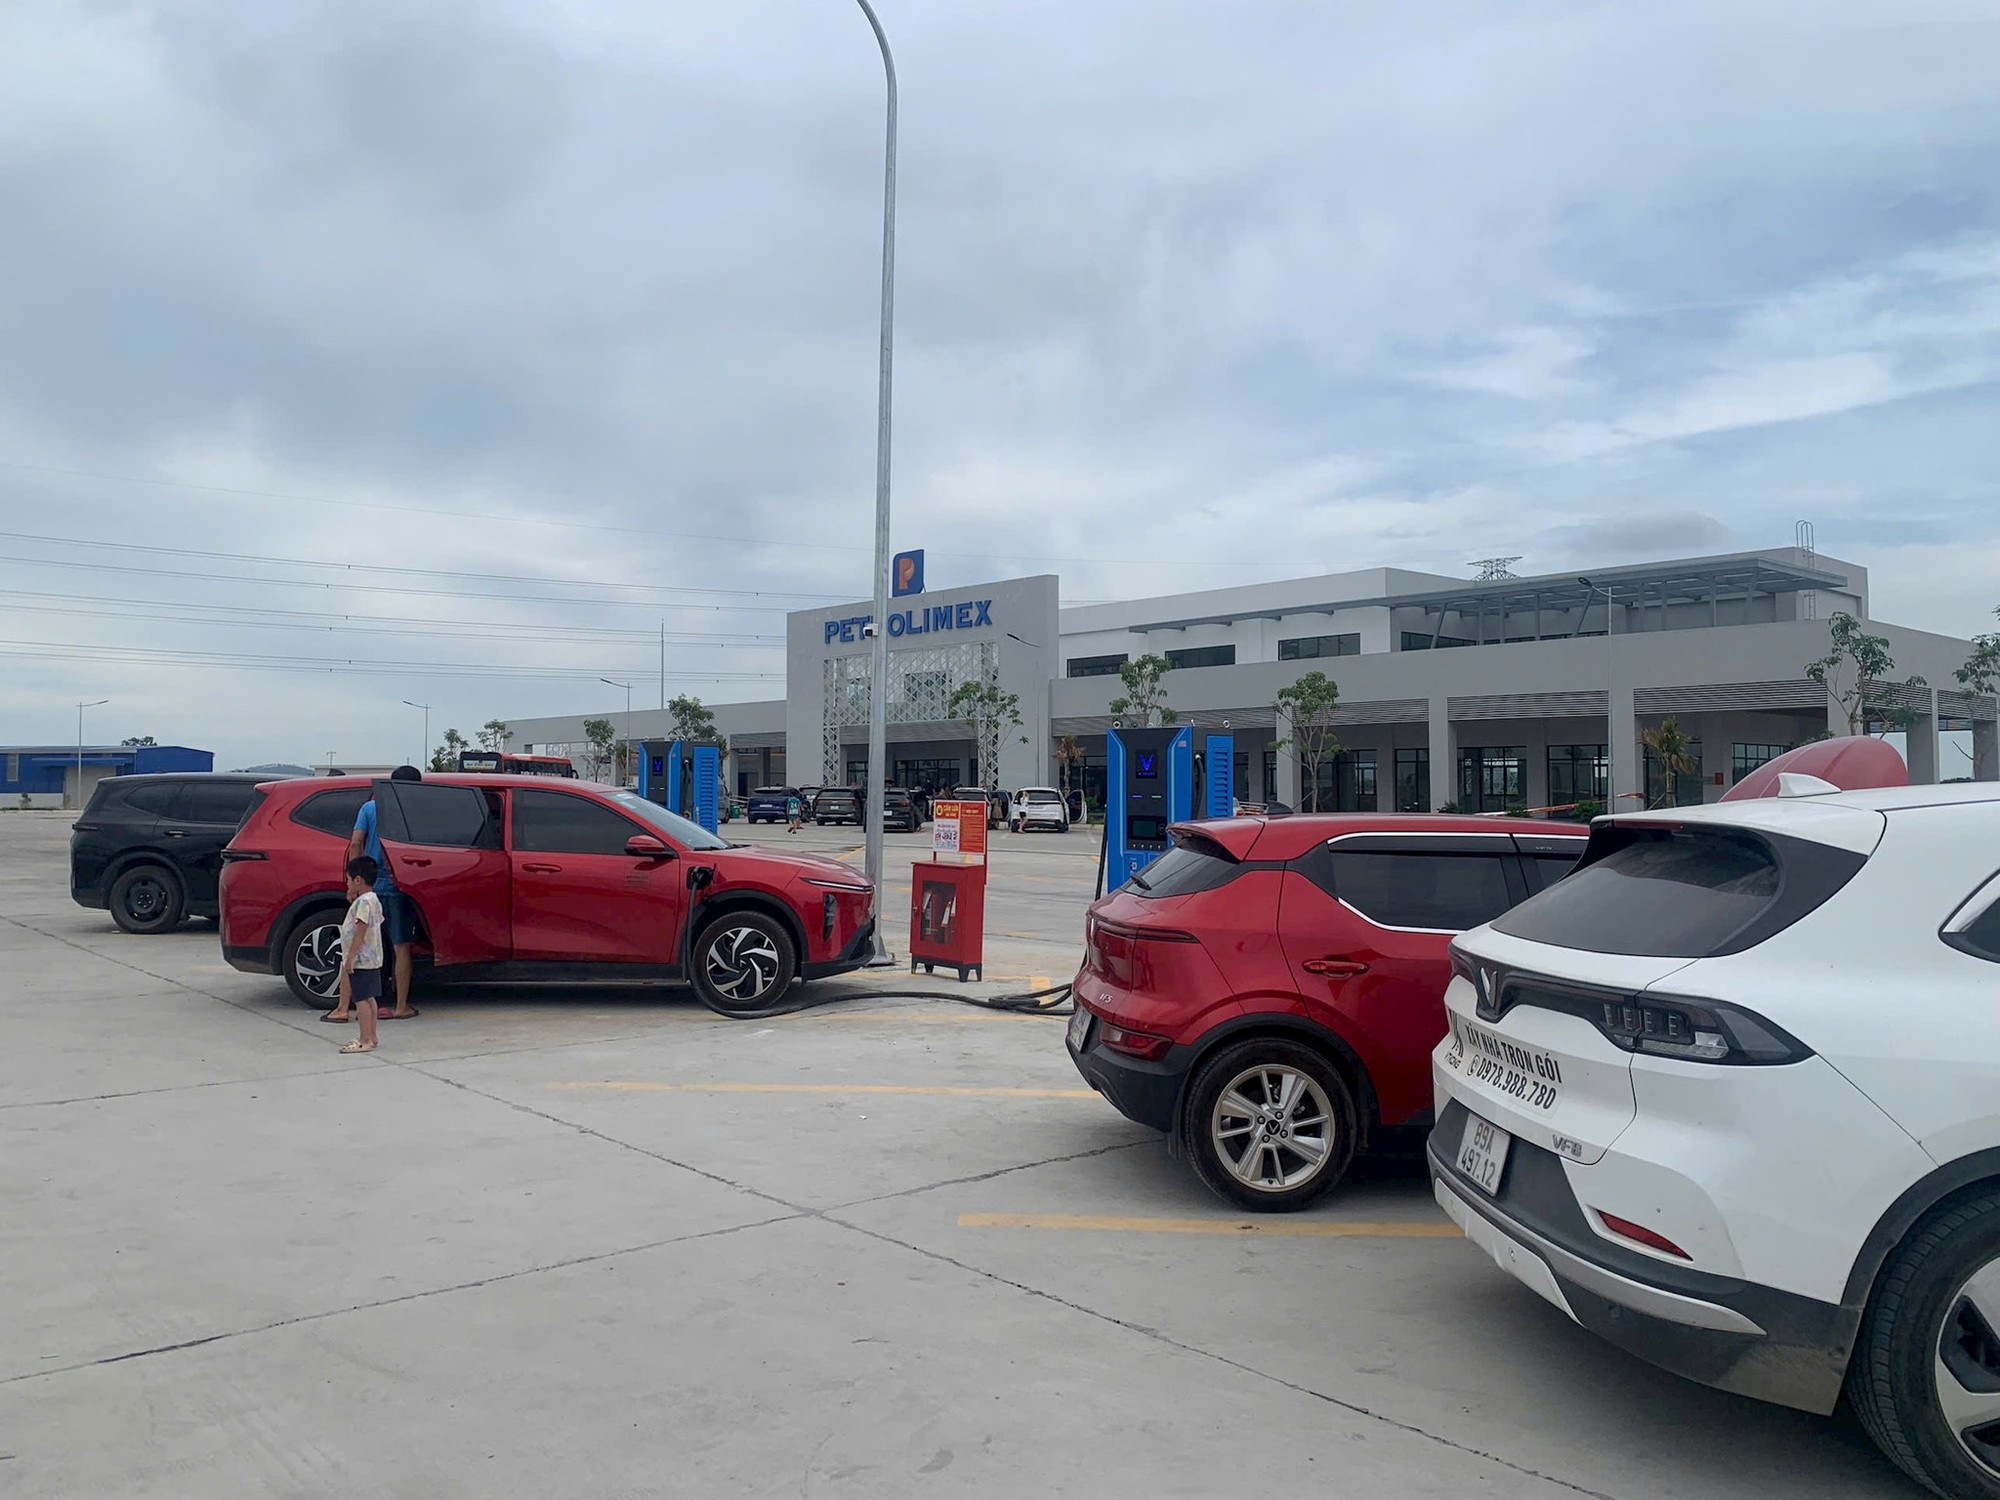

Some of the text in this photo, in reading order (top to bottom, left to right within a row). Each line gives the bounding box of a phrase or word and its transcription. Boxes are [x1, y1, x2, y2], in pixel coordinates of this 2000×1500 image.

[824, 599, 993, 645] PETOLIMEX
[1481, 1033, 1503, 1060] NHÀ
[1500, 1041, 1535, 1075] TRỌN
[1535, 1052, 1562, 1083] GÓI
[1476, 1057, 1557, 1110] 0978.988.780
[1473, 1122, 1495, 1155] 89A
[1461, 1146, 1496, 1188] 497.12
